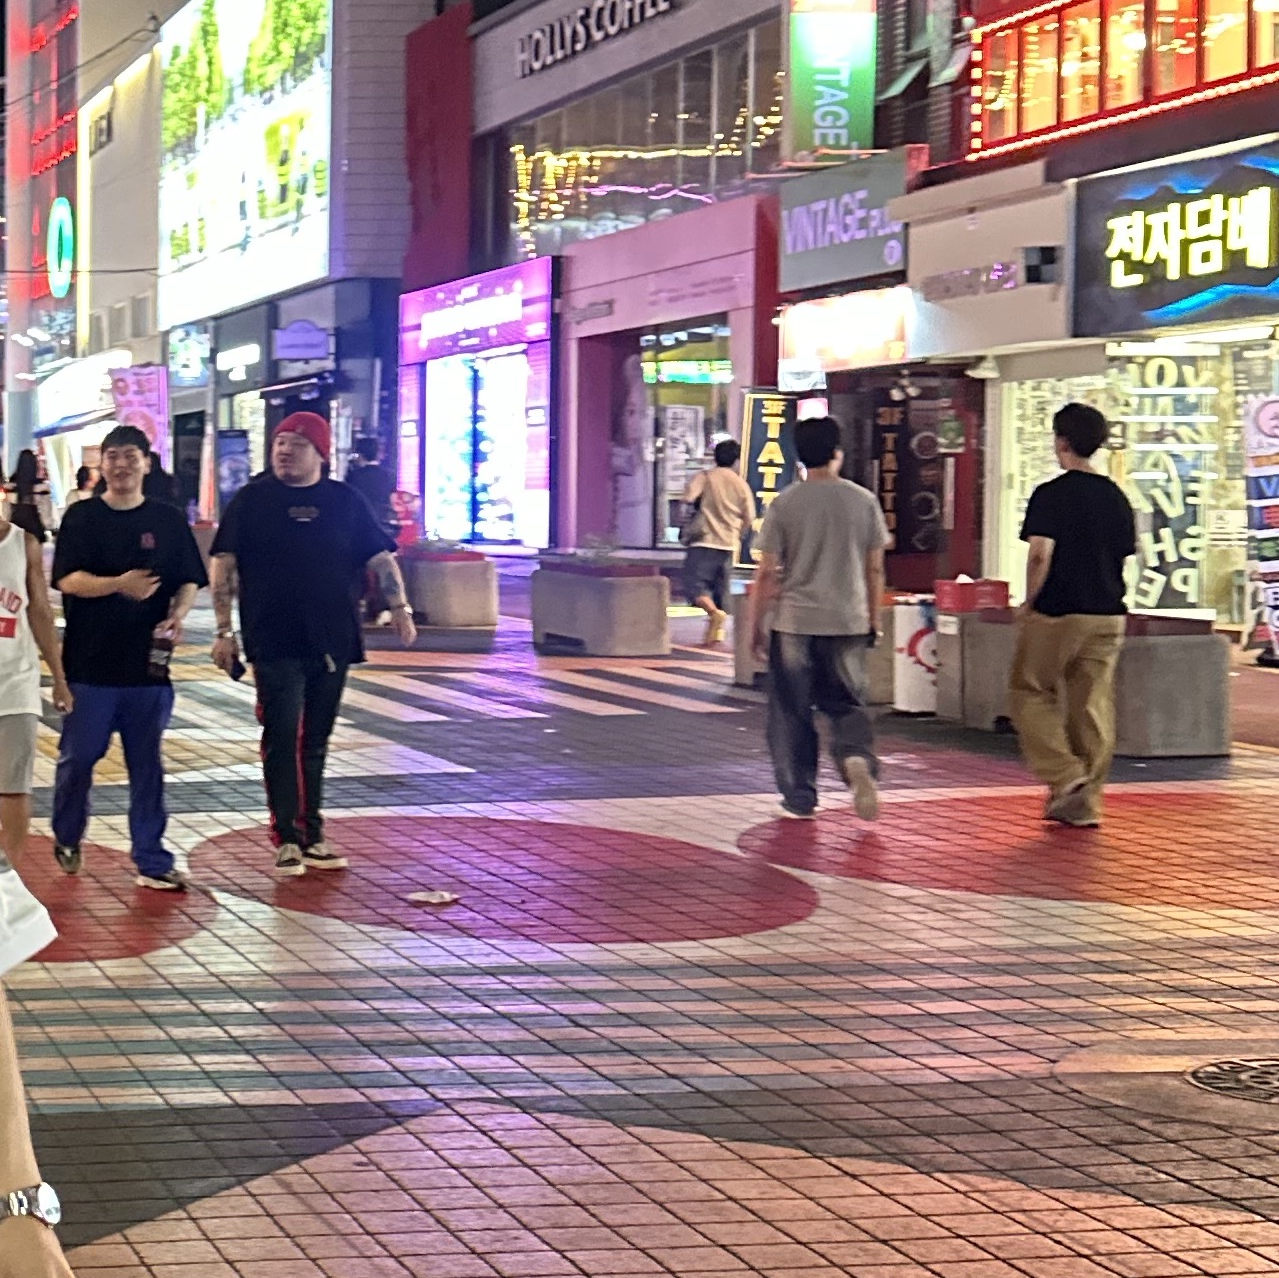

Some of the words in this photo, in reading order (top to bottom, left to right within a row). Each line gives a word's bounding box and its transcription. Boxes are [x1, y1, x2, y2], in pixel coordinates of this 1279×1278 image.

[515, 8, 588, 78] HOLLYS
[589, 0, 671, 41] COFF
[813, 50, 852, 147] NTAGE
[782, 189, 868, 255] VINTAGE
[1105, 186, 1271, 288] 전자담배
[750, 416, 786, 562] TATT
